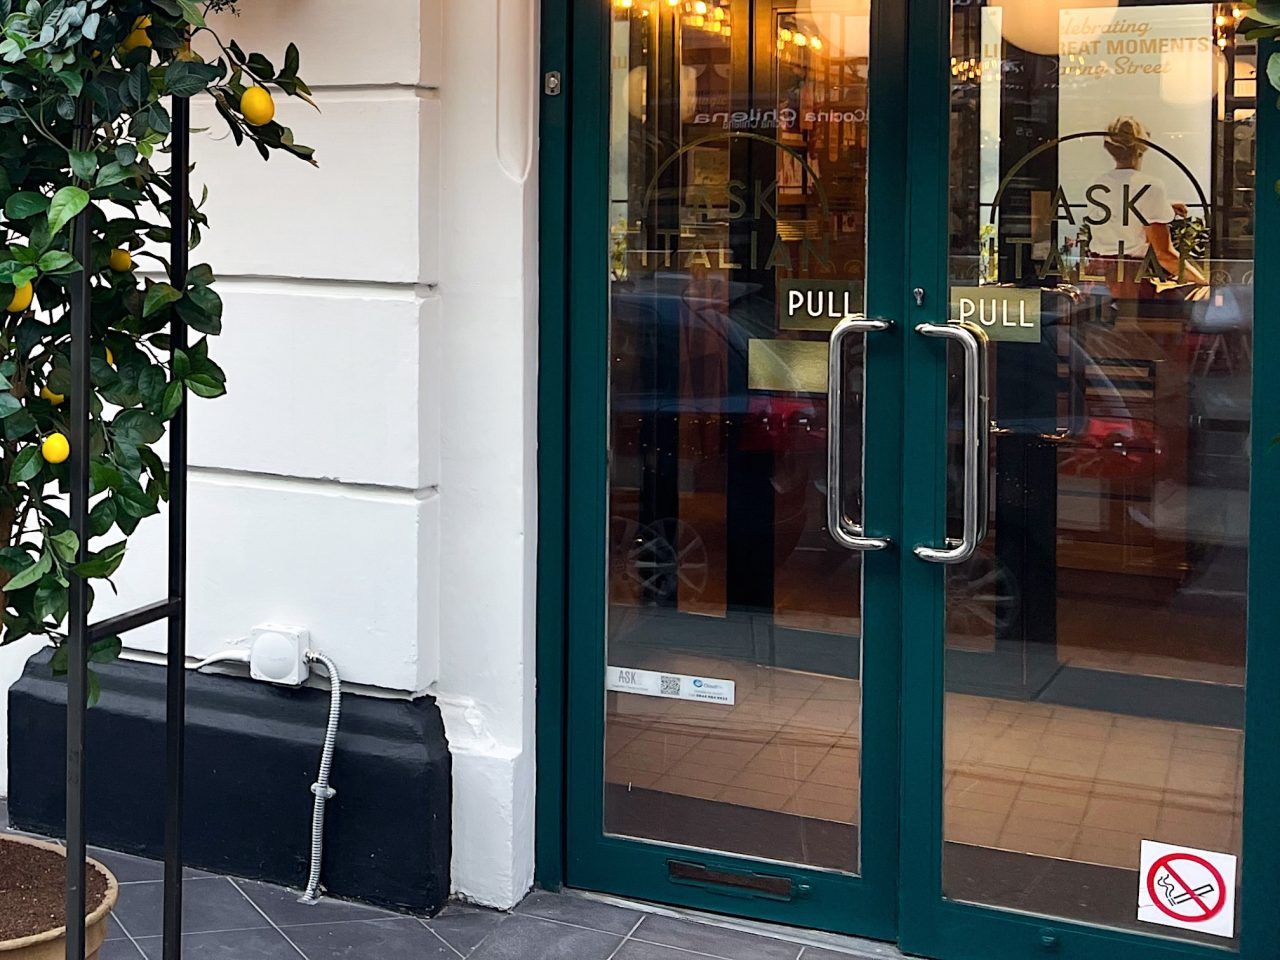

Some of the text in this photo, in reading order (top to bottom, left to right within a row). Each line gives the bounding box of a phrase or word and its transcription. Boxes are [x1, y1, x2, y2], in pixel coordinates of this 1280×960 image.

[1106, 36, 1210, 55] MOMENTS
[1049, 183, 1153, 227] ASK
[988, 236, 1211, 285] ITALIAN
[788, 290, 858, 318] PULL
[959, 298, 1035, 328] PULL
[618, 670, 636, 684] ASK
